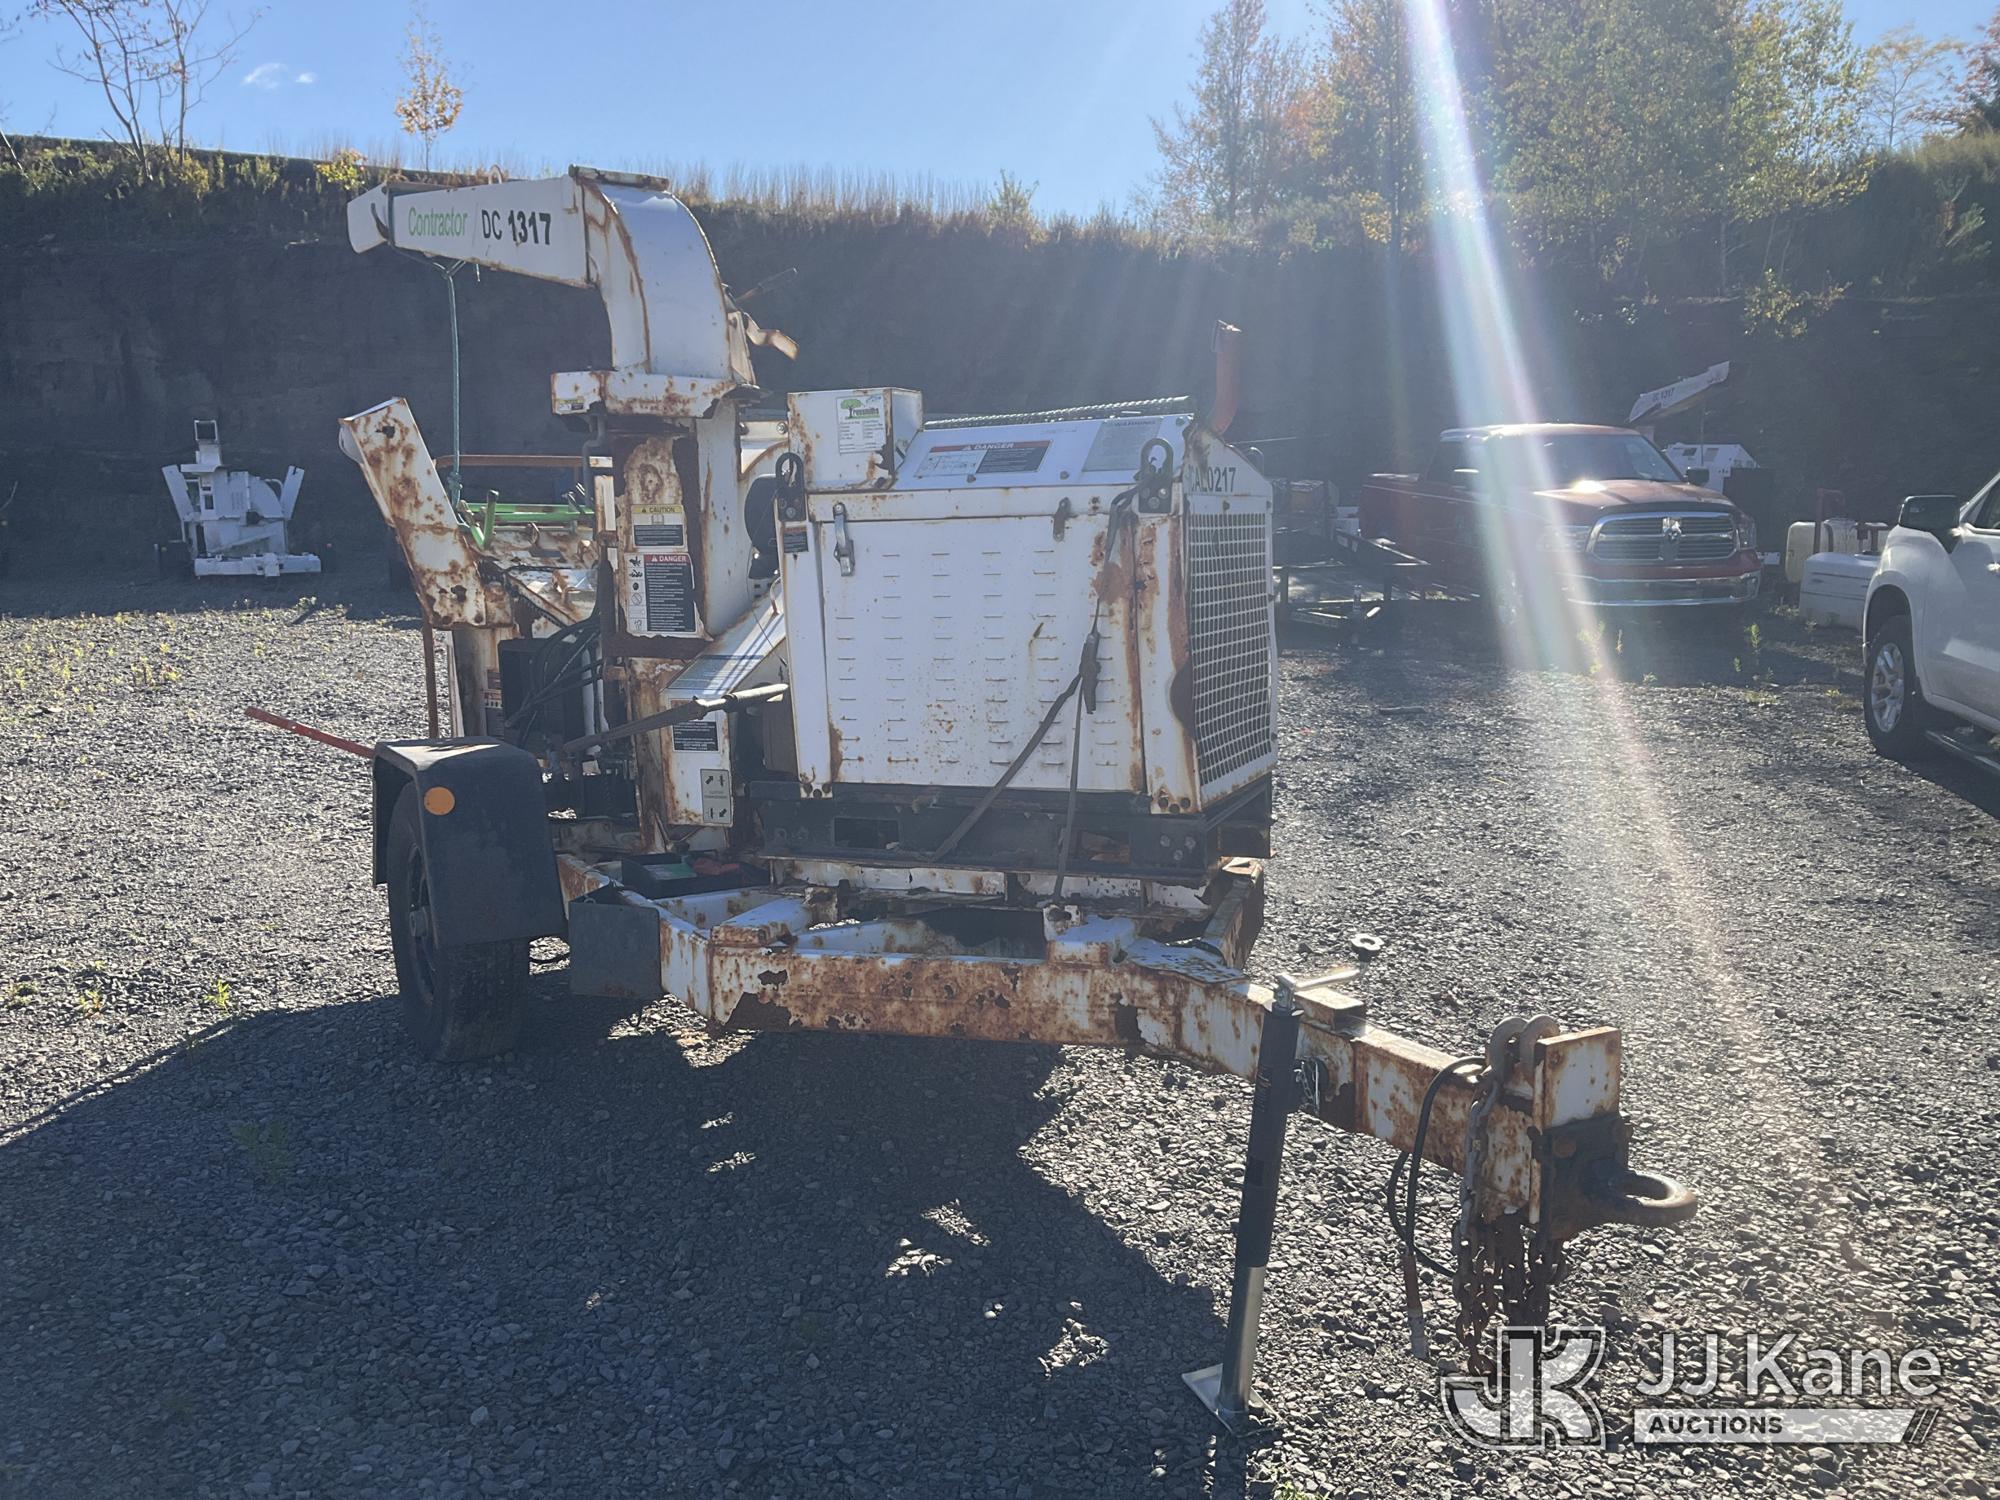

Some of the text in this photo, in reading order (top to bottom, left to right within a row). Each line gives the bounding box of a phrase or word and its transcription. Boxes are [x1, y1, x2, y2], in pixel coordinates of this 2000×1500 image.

[408, 206, 551, 245] Contractor DC 1317
